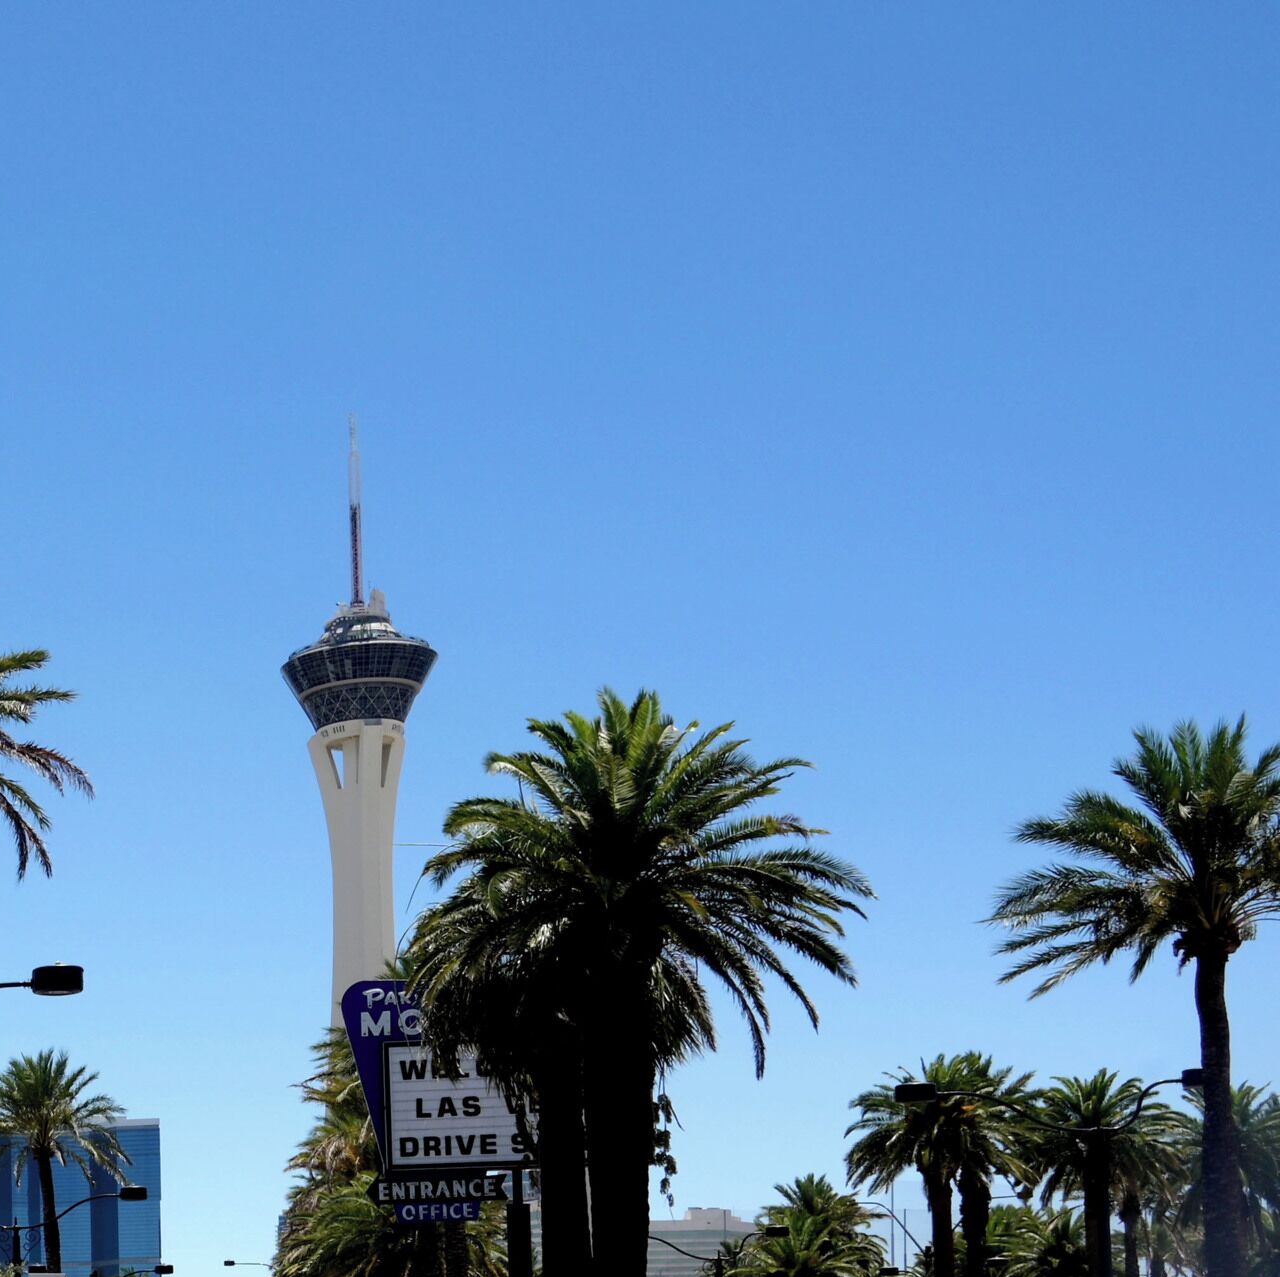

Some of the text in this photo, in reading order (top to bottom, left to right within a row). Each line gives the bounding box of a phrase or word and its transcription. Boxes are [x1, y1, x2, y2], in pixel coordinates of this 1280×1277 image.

[415, 1096, 481, 1119] LAS
[399, 1133, 498, 1158] DRIVE
[378, 1178, 497, 1201] ENTRANCE
[401, 1202, 474, 1221] OFFICE
